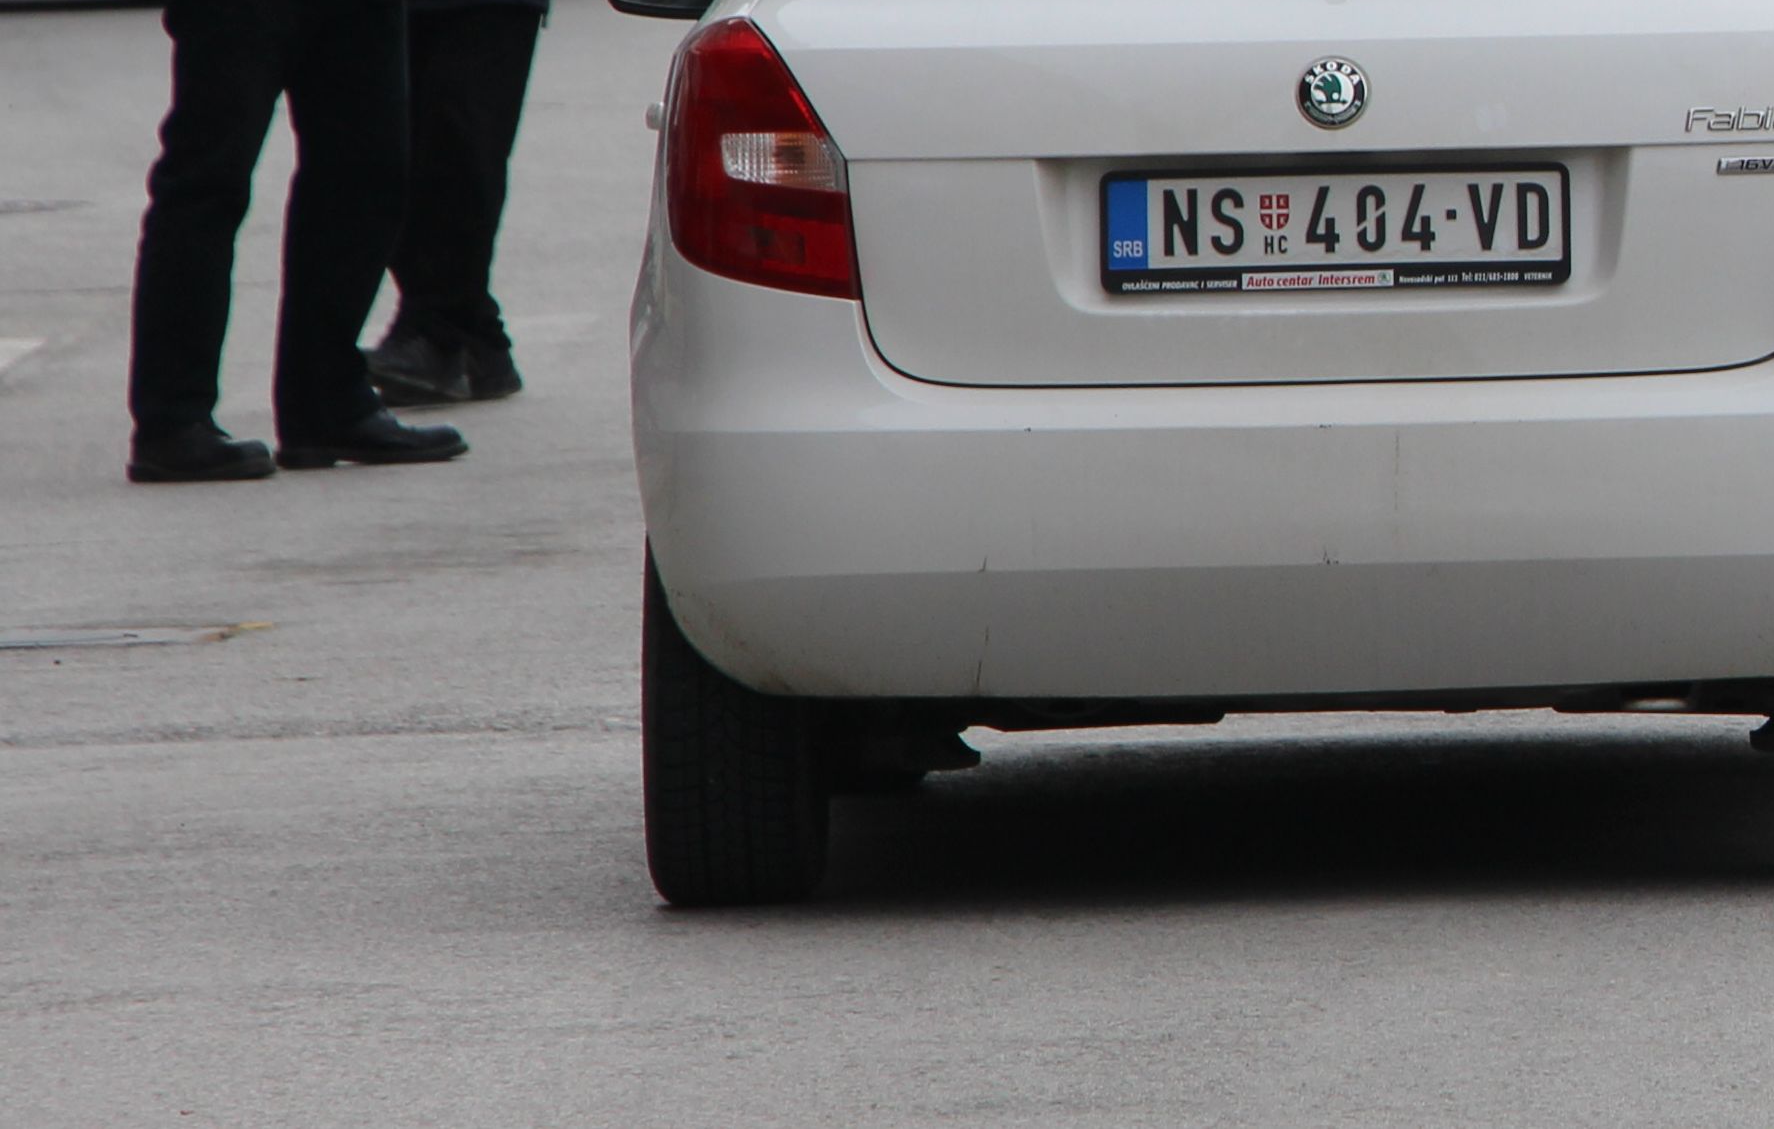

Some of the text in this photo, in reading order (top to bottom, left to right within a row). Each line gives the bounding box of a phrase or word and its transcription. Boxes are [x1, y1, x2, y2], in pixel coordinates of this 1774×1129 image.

[1740, 158, 1774, 171] 16V
[1163, 188, 1245, 257] NS
[1113, 241, 1144, 258] SRB
[1247, 276, 1274, 287] Auto
[1277, 274, 1314, 286] centar
[1318, 273, 1375, 285] Intersrem
